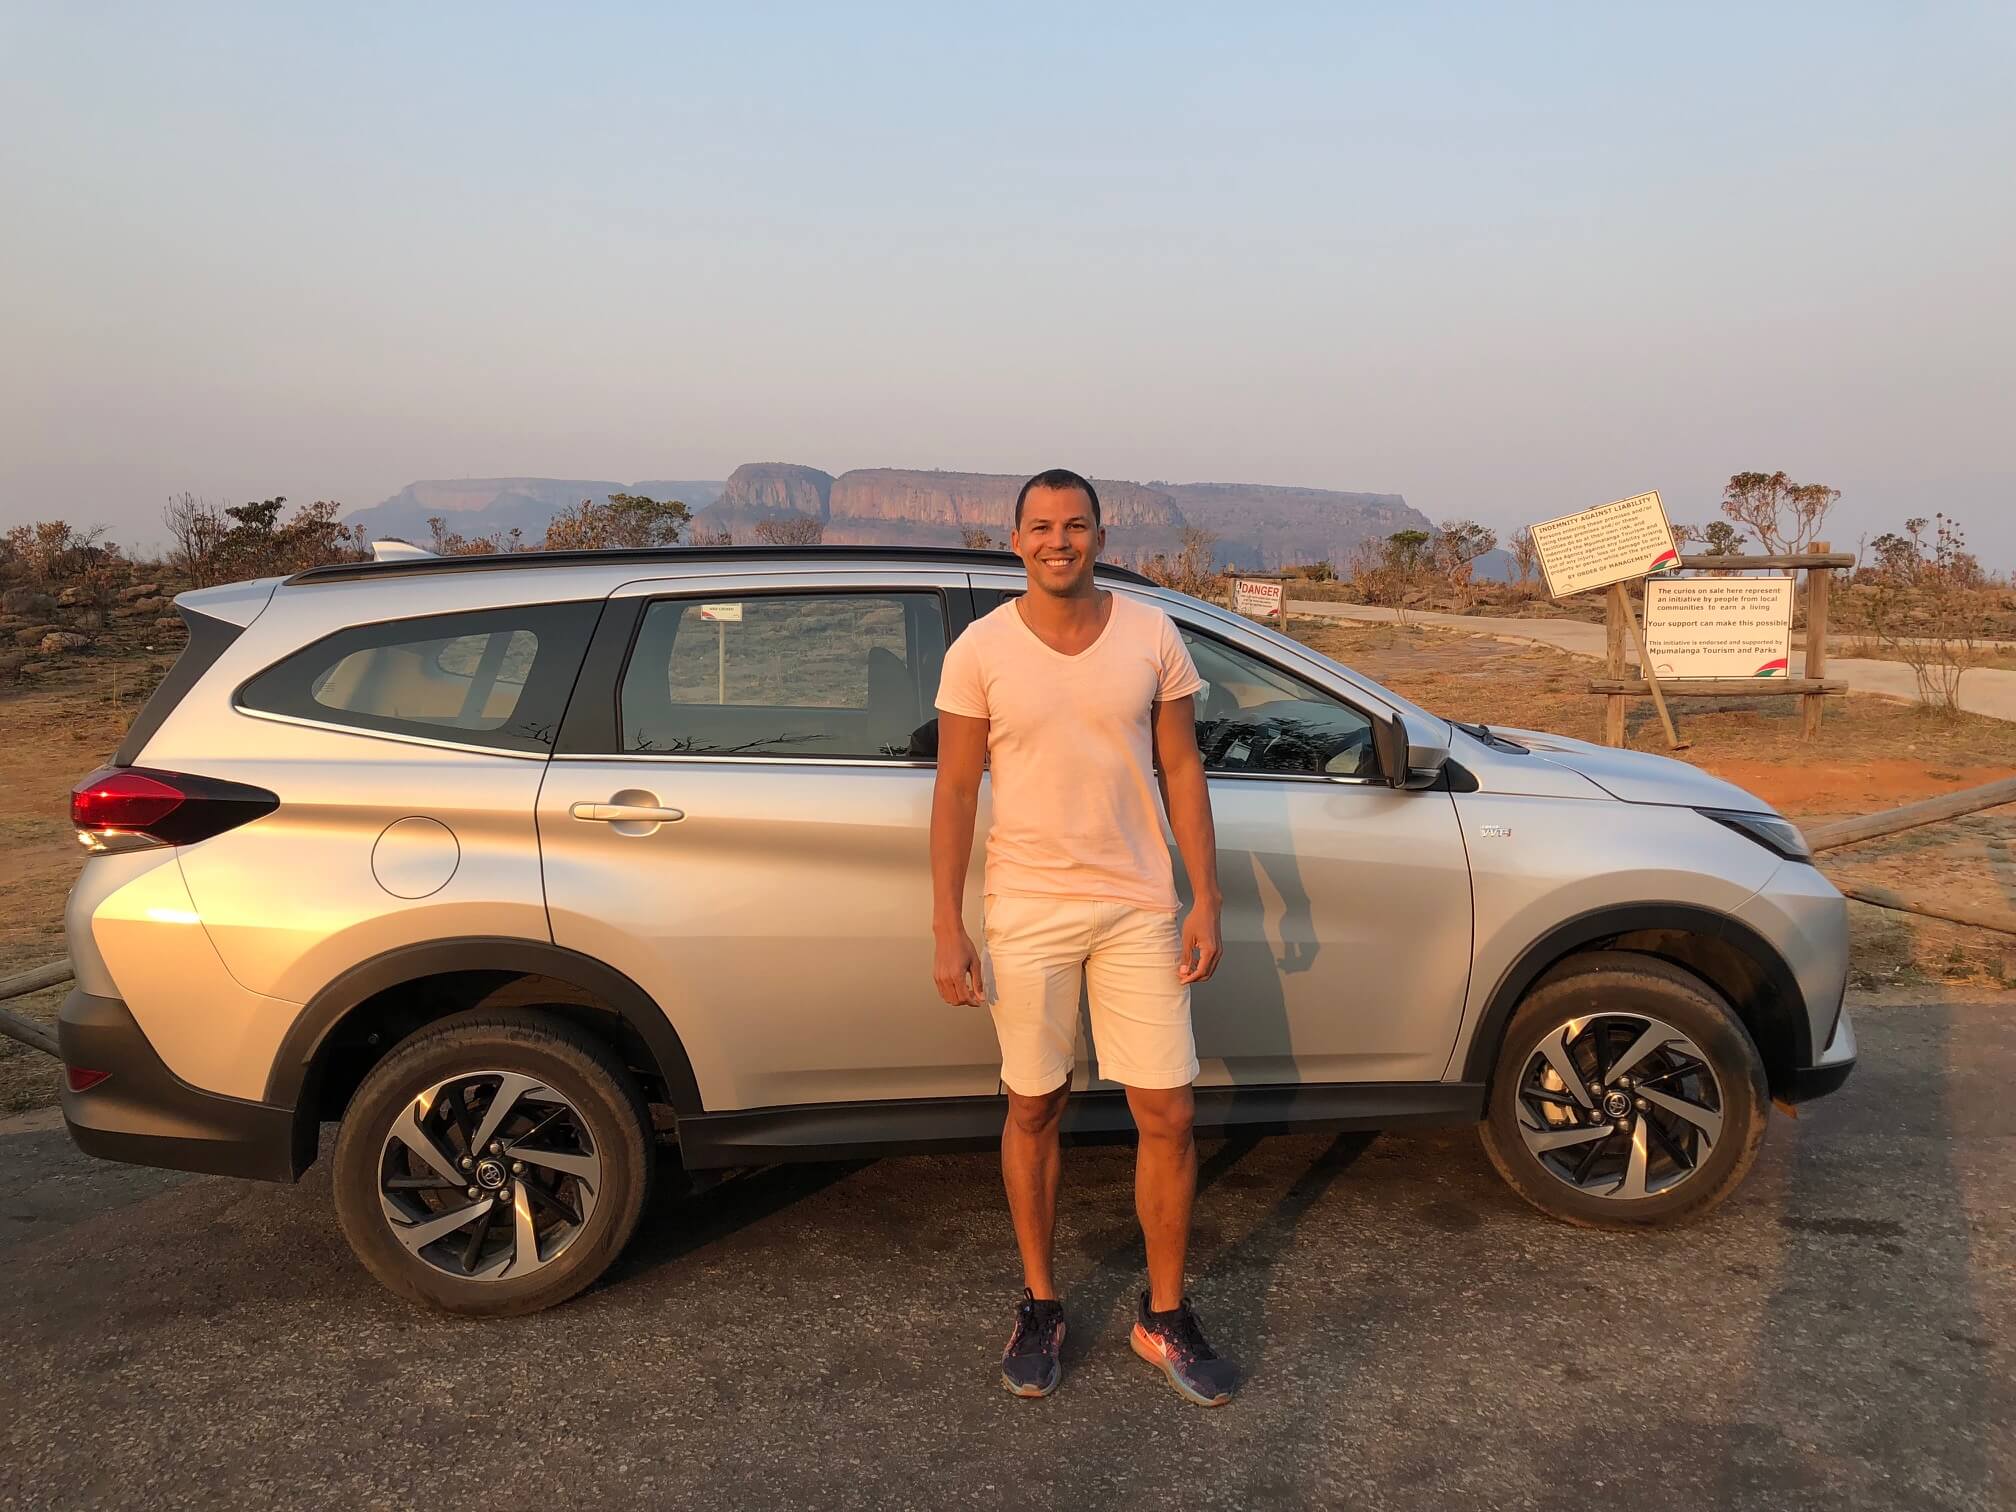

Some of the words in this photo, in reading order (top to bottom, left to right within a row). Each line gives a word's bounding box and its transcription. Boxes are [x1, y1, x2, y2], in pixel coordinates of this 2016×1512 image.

[1539, 518, 1578, 533] INDEMNITY
[1580, 509, 1612, 521] AGAINST
[1614, 497, 1651, 512] LIABILITY
[1604, 512, 1631, 523] premises
[1574, 527, 1600, 538] premises
[1609, 554, 1652, 568] MANAGEMENT
[1242, 584, 1279, 597] DANGER
